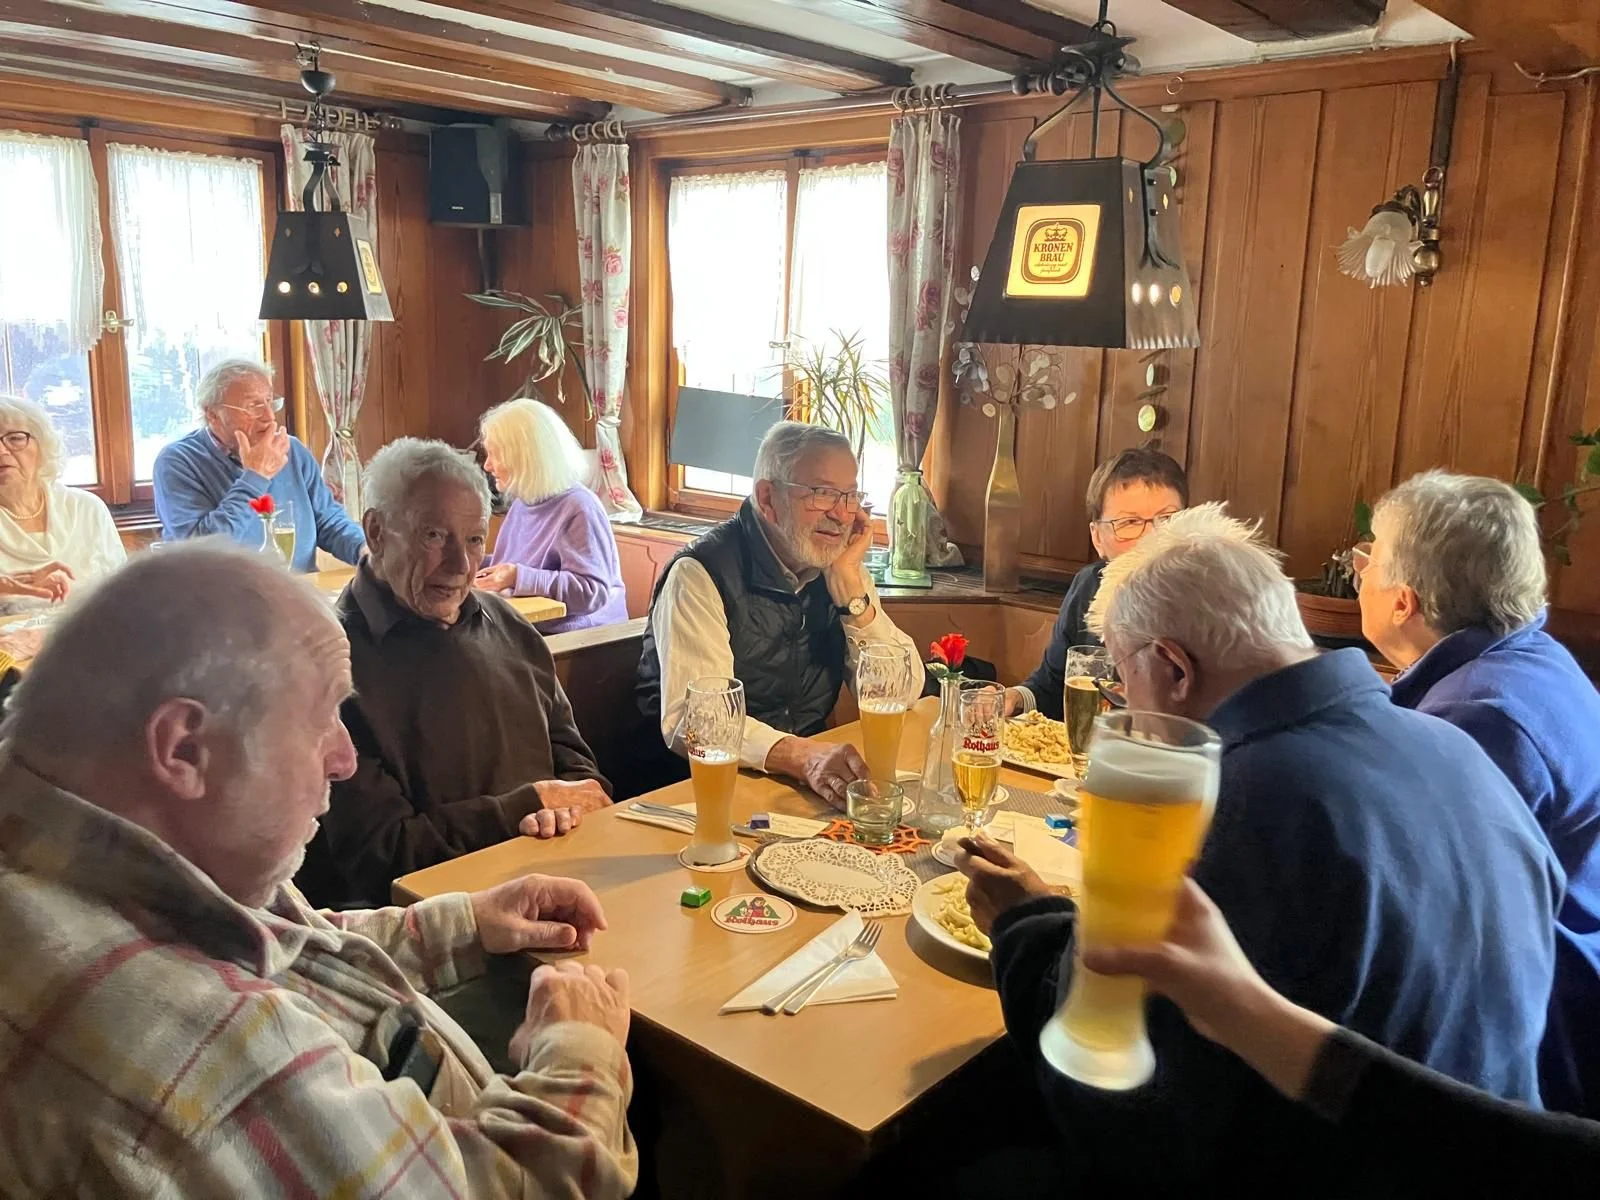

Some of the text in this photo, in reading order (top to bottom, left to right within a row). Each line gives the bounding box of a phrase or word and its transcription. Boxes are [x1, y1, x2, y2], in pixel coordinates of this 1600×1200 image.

[1033, 242, 1074, 253] KRONEN
[963, 737, 1000, 753] Rothaus
[724, 915, 779, 926] Rothaus
